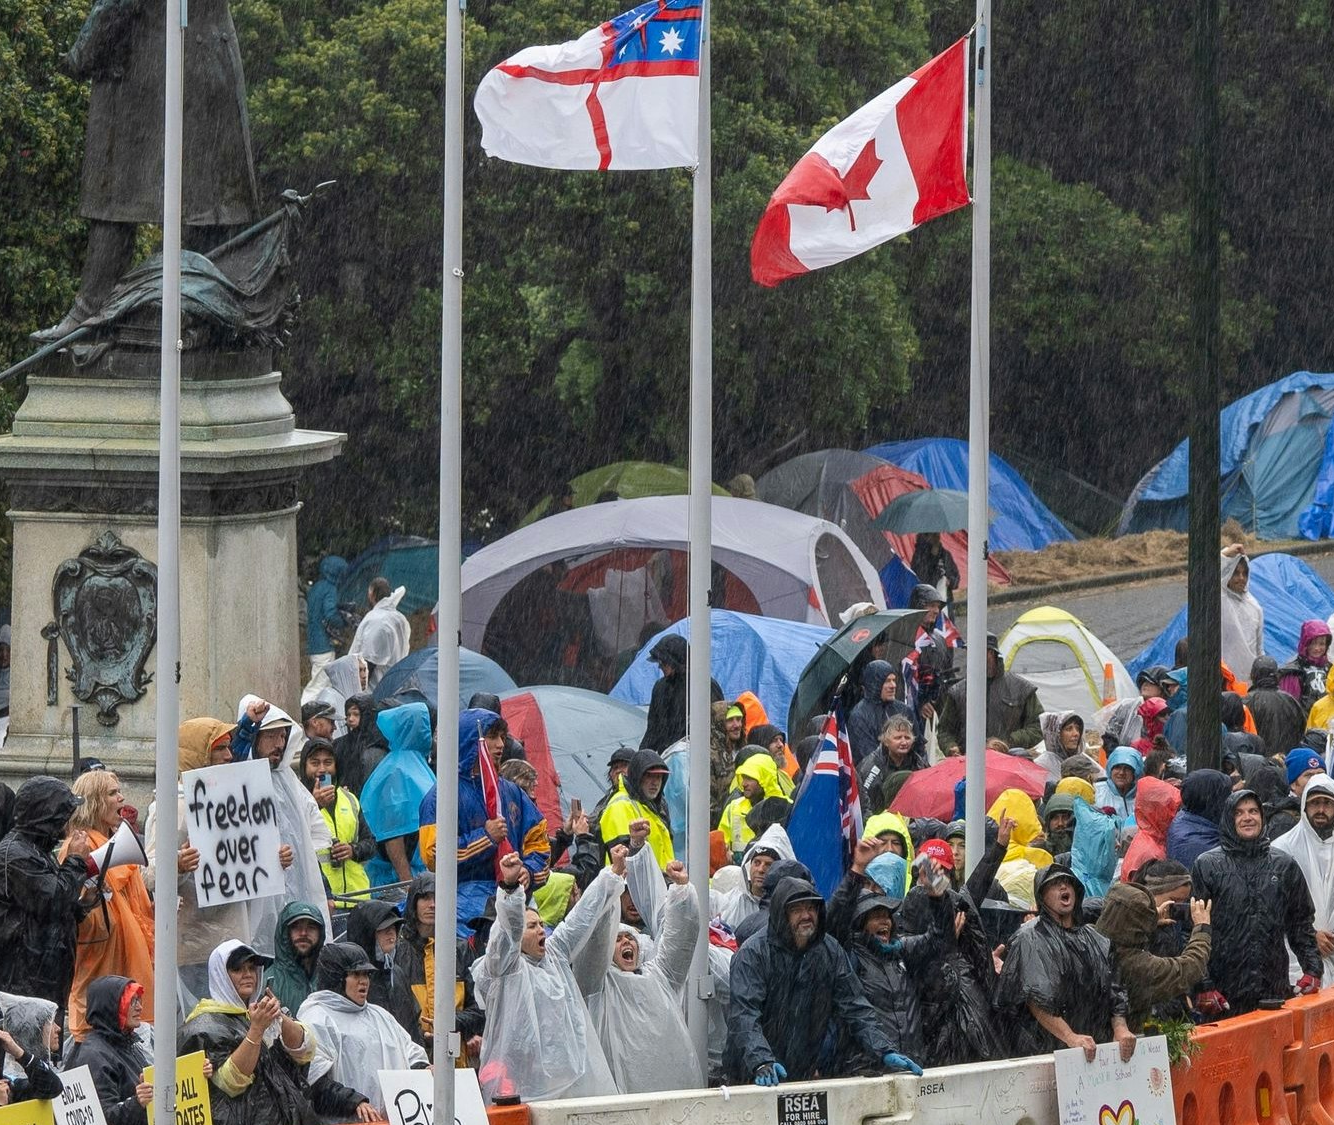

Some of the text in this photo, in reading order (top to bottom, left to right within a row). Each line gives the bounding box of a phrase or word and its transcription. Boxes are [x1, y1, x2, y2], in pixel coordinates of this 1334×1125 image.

[189, 778, 277, 830] freedom
[216, 834, 259, 866] over
[201, 862, 268, 902] fear
[74, 1082, 86, 1101] ALL
[181, 1078, 198, 1101] ALL
[785, 1096, 820, 1113] RSEA
[786, 1112, 820, 1121] FOR HIRE
